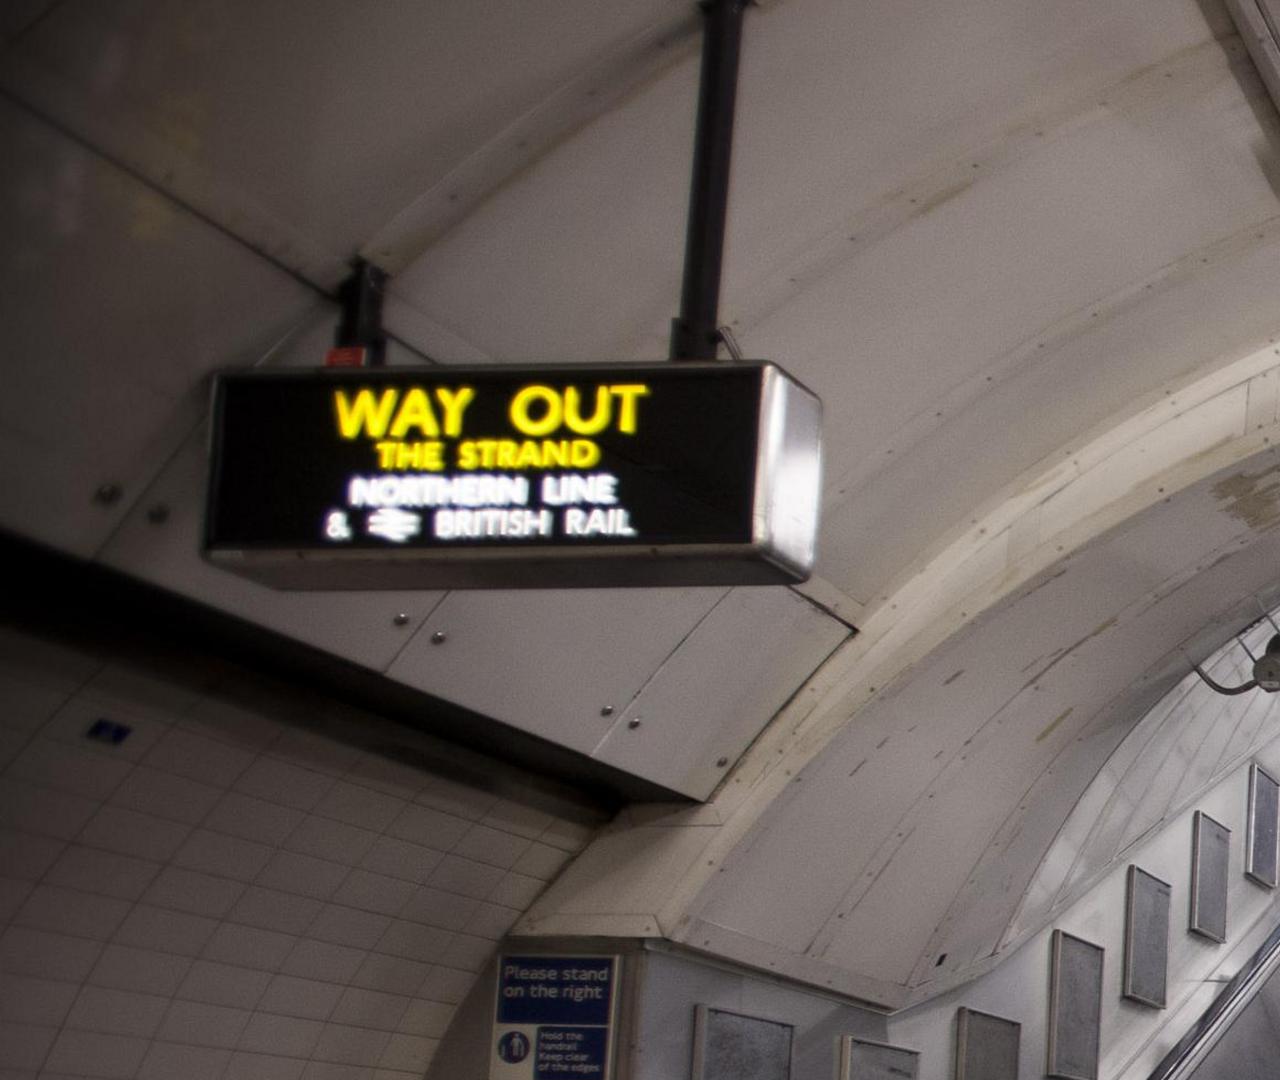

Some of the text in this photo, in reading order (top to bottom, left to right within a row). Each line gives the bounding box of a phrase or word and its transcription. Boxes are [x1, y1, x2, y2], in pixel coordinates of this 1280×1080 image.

[335, 384, 648, 438] WAY OUT
[375, 439, 599, 471] THE STRAND
[348, 473, 618, 507] NORTHERN LINE
[326, 508, 635, 539] & BRITISH RAIL
[504, 965, 609, 981] Please stand
[504, 985, 603, 1002] on the right
